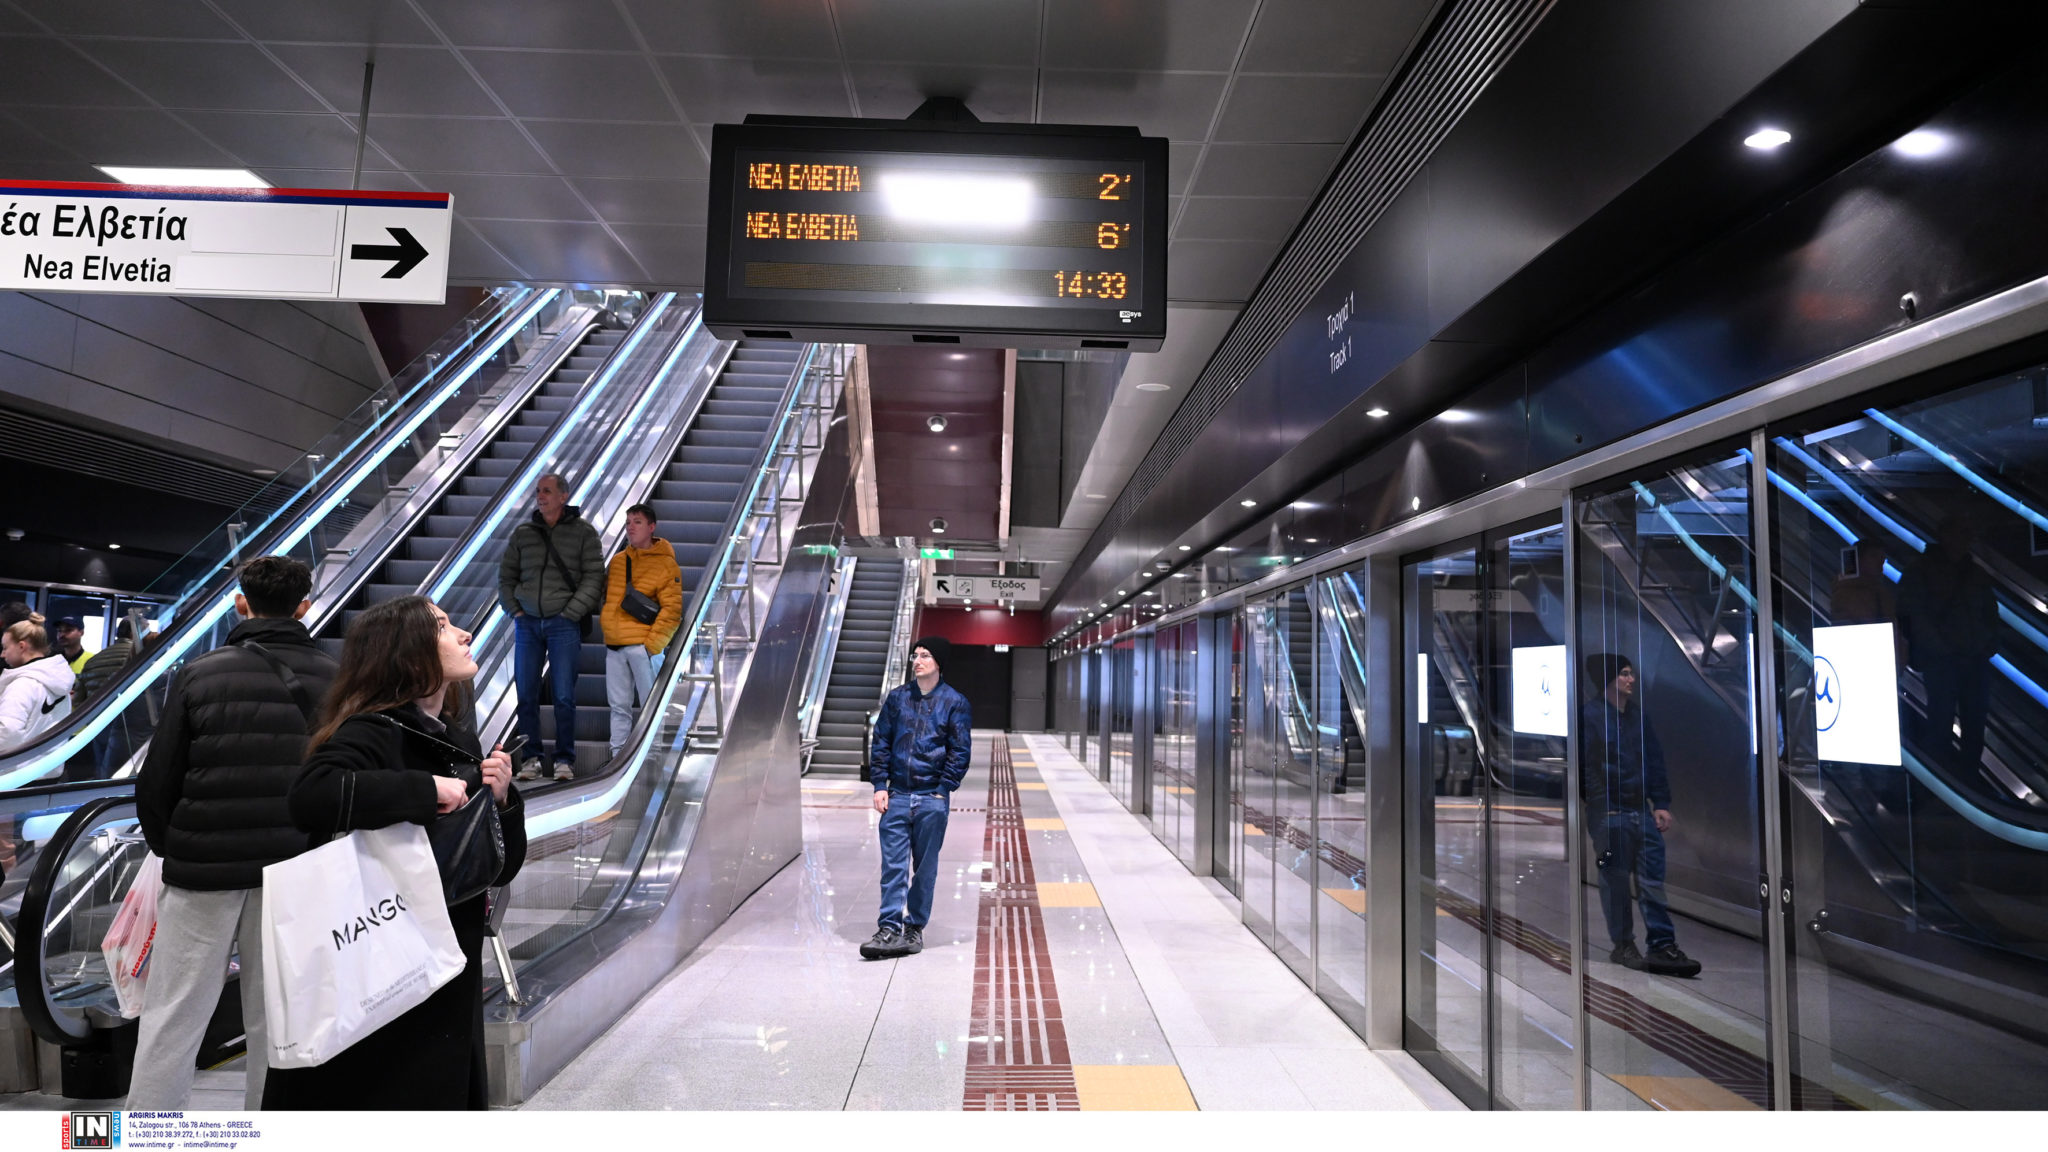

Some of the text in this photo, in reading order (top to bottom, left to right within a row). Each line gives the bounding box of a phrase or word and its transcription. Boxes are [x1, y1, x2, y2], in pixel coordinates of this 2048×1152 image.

[749, 163, 783, 190] ΝΕΑ
[788, 164, 860, 192] ΕΛΒΕΤΙΑ
[0, 202, 187, 247] έα Ελβετία
[746, 211, 780, 239] ΝΕΑ
[786, 213, 858, 241] ΕΛΒΕΤΙΑ
[23, 253, 172, 283] Nea Elvetia
[1054, 270, 1127, 299] 14:33
[1349, 290, 1354, 315] 1
[1329, 335, 1352, 375] Track 1
